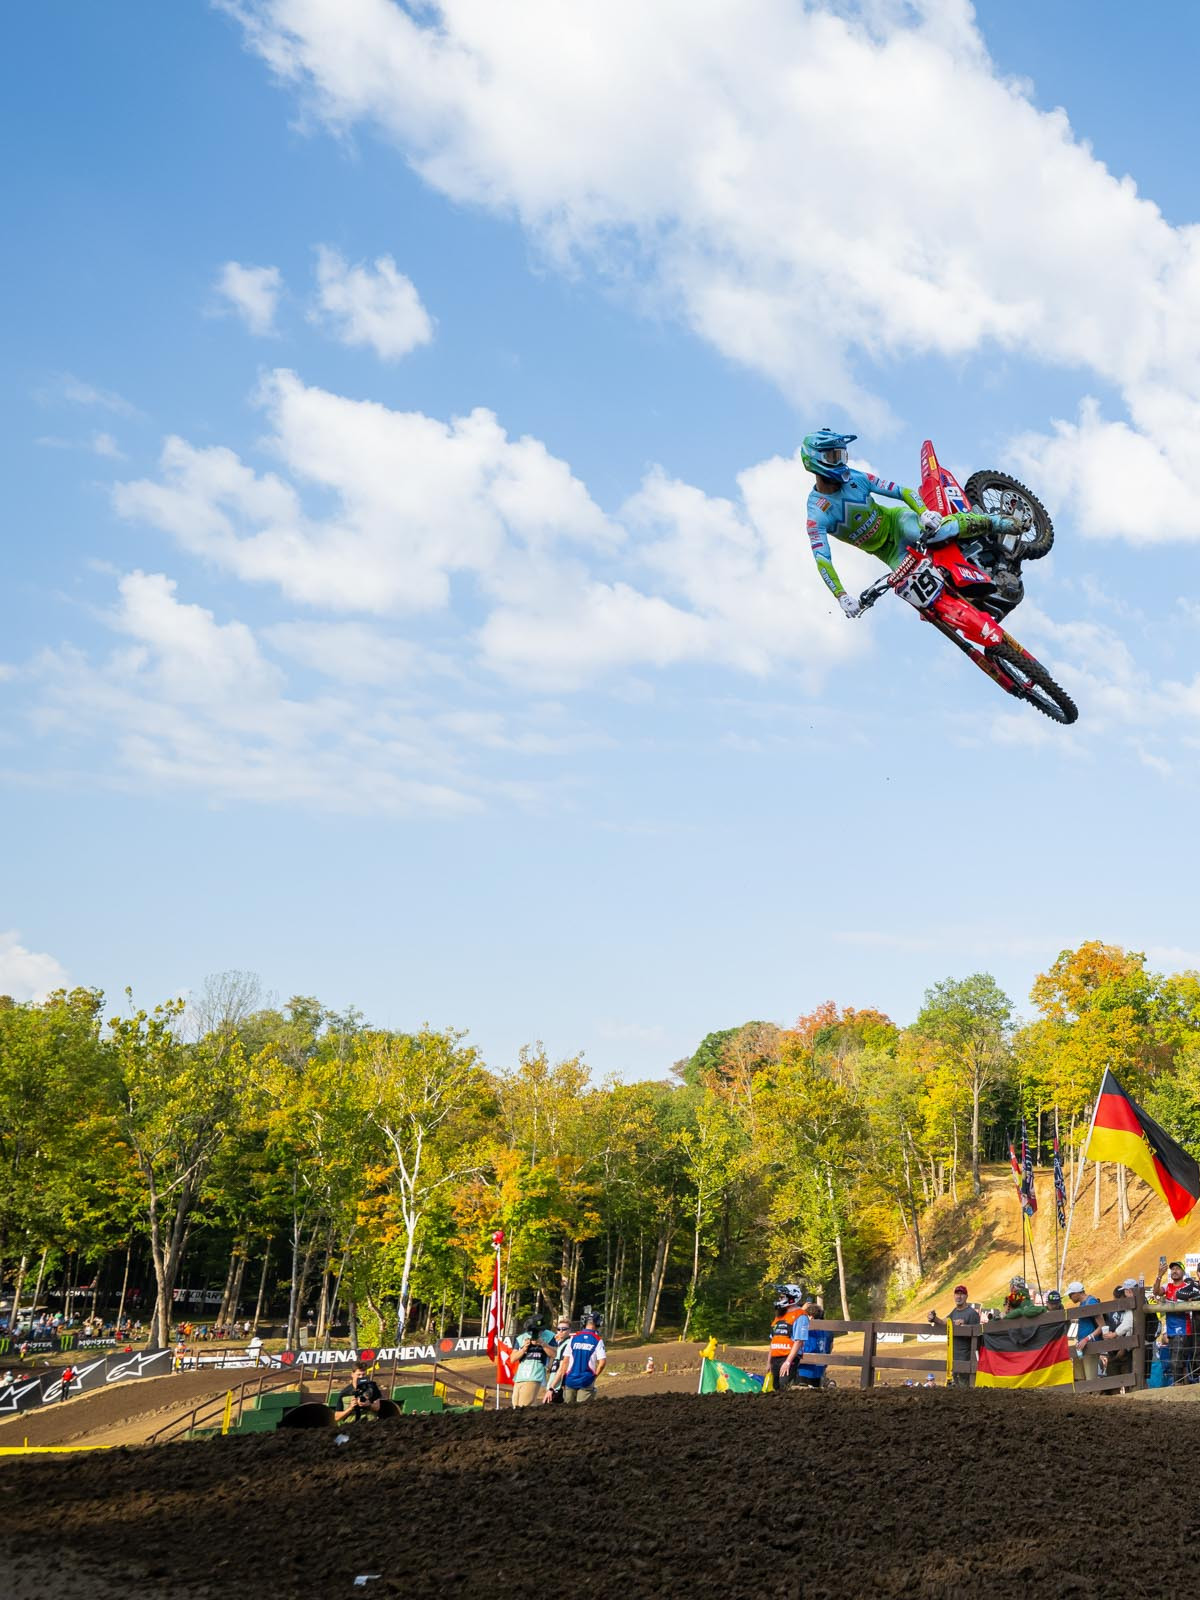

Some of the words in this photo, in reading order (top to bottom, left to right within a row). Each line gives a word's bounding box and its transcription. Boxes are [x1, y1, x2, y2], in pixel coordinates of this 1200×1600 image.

[936, 485, 945, 510] HONDA
[909, 568, 939, 604] 19
[14, 1341, 53, 1350] MNSTER
[78, 1338, 116, 1347] MONSTER
[454, 1334, 514, 1352] ATHEA
[295, 1349, 358, 1365] ATHENA
[375, 1345, 437, 1361] ATHENA
